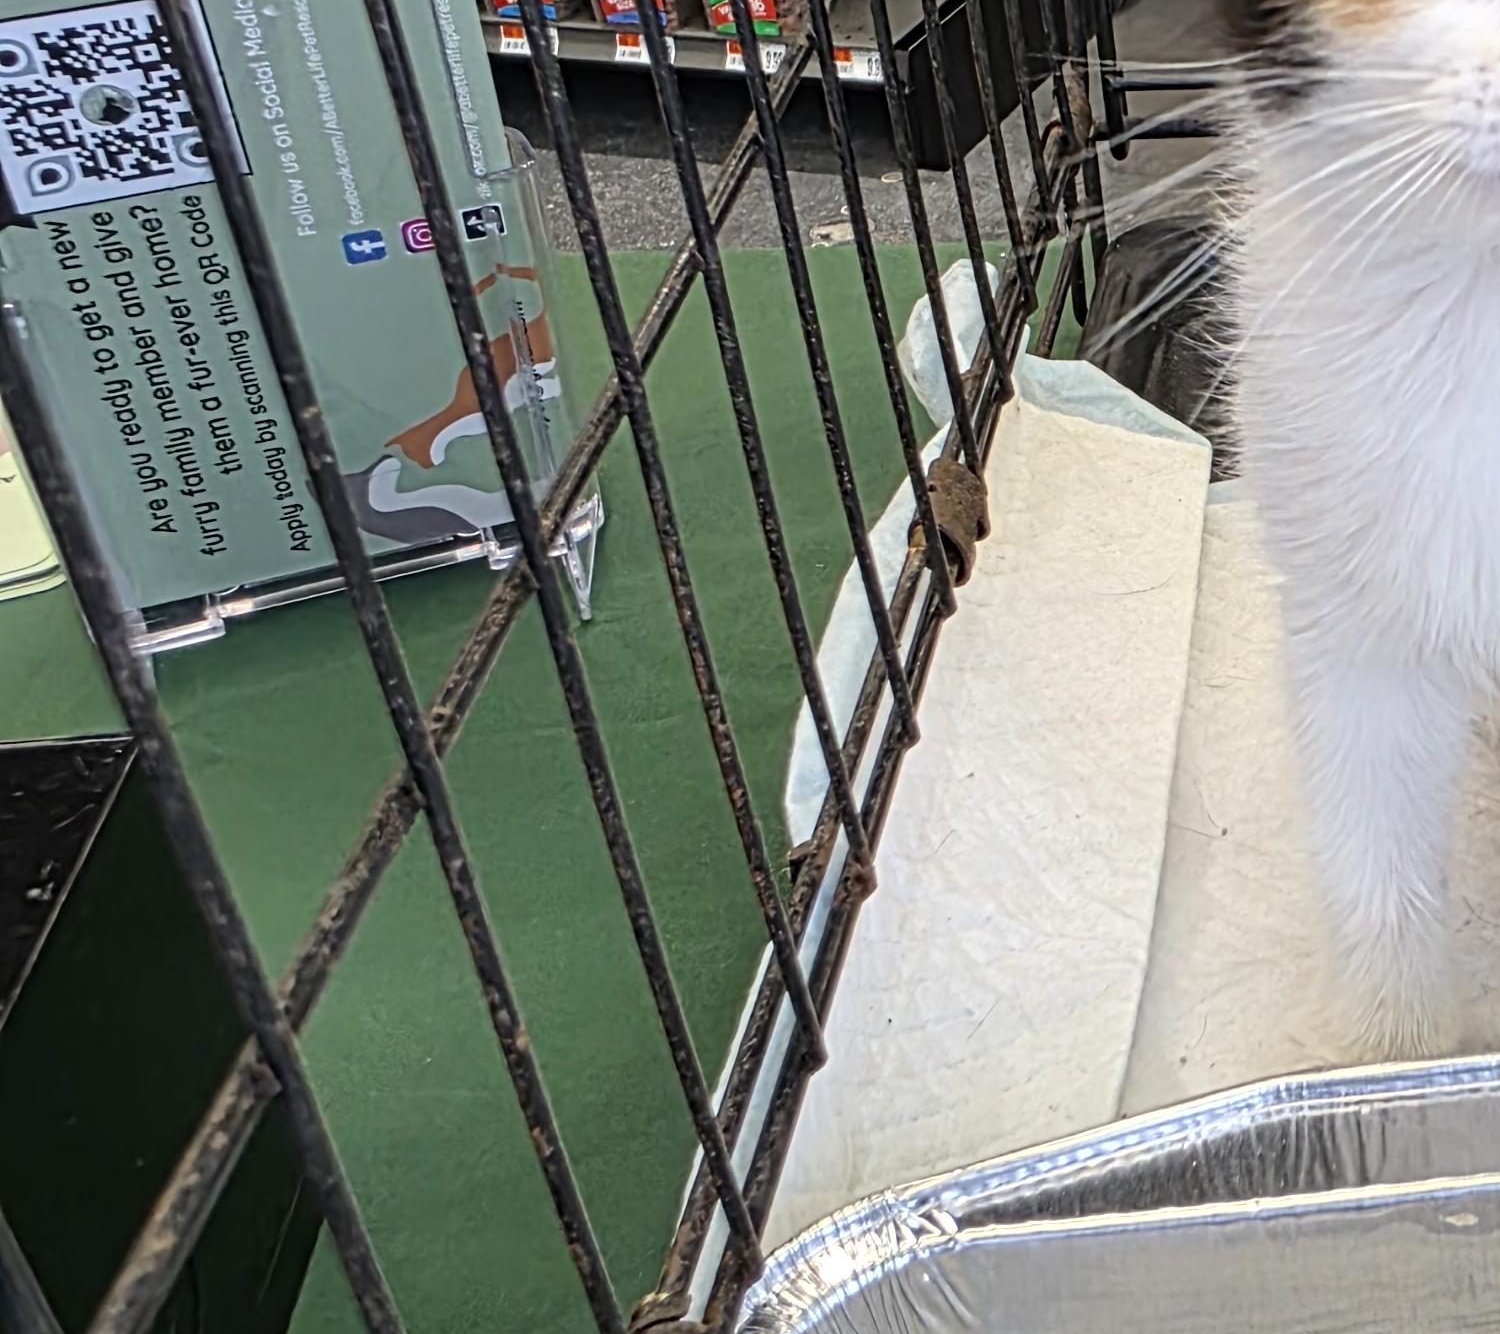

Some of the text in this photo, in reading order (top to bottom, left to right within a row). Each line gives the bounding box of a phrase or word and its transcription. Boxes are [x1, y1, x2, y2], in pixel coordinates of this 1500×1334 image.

[250, 59, 285, 119] Social
[273, 123, 293, 148] on
[281, 150, 301, 174] us
[288, 178, 317, 236] Follow
[43, 221, 178, 533] Are you ready to get a new
[91, 211, 228, 556] furry family member and give
[128, 205, 243, 475] them a fur-ever home?
[179, 195, 313, 552] Apply today by scanning this QR Code
